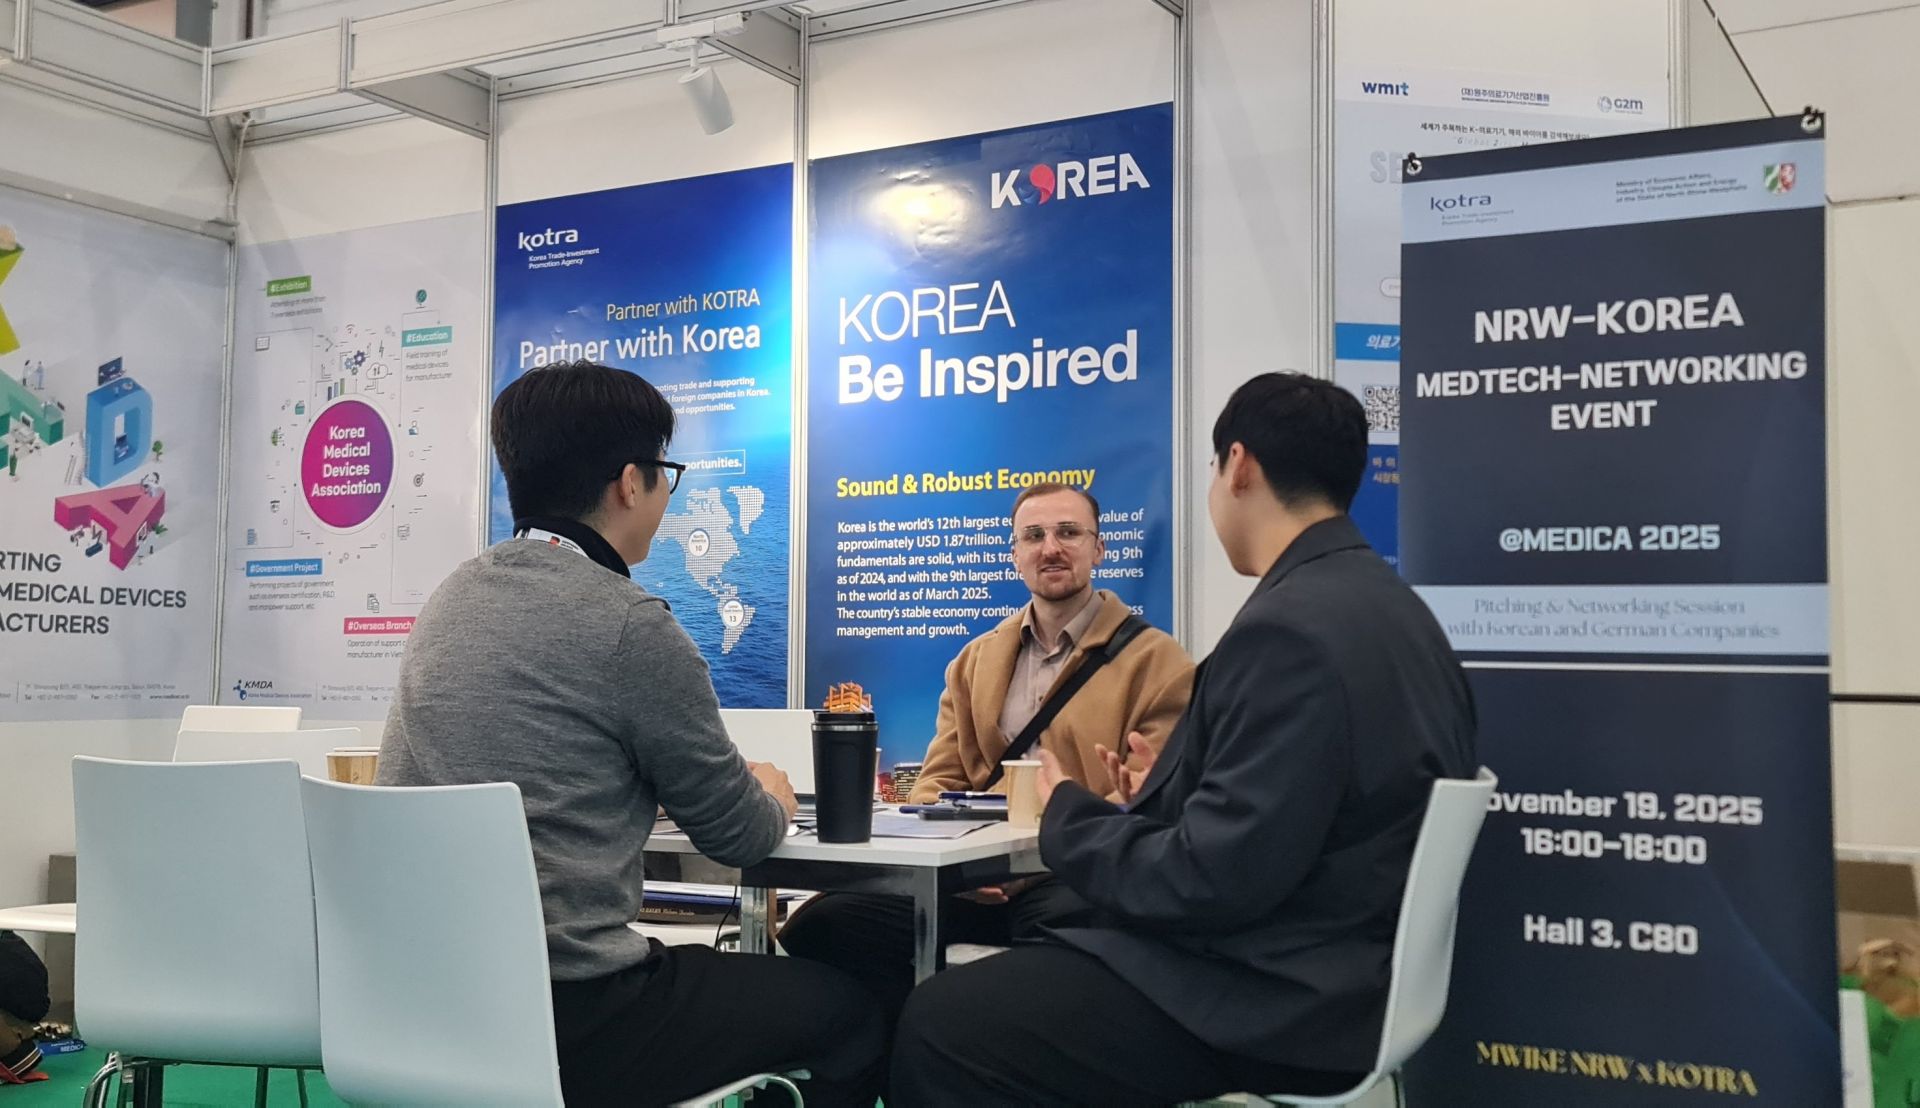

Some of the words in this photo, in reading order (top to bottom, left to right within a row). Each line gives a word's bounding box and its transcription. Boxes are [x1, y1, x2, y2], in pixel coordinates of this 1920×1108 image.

[1614, 98, 1643, 110] G2m
[1430, 194, 1492, 212] kotra
[518, 227, 579, 252] kotra
[548, 247, 600, 260] Trade-Investment
[528, 261, 560, 270] Promotion
[561, 257, 584, 267] Agency
[606, 302, 661, 322] Partner
[664, 293, 698, 317] with
[702, 287, 761, 311] KOTRA
[838, 280, 1017, 345] KOREA
[1474, 292, 1744, 344] NRW-KOREA
[406, 331, 449, 344] #Education
[519, 338, 610, 368] Partner
[616, 325, 673, 360] with
[682, 323, 761, 356] Korea
[838, 354, 904, 404] Be
[920, 329, 1138, 403] Inspired
[1416, 350, 1808, 398] MEDTECH-NETWORKING
[655, 383, 678, 393] oting
[679, 381, 698, 390] trade
[698, 379, 712, 388] and
[713, 376, 755, 389] supporting
[672, 393, 697, 404] foreign
[697, 390, 737, 402] companies
[737, 389, 745, 398] in
[686, 402, 736, 416] opportunities.
[1551, 399, 1658, 431] EVENT
[329, 426, 365, 440] Korea
[324, 442, 371, 459] Medical
[323, 464, 370, 478] Devices
[685, 457, 743, 471] portunities.
[311, 481, 382, 497] Association
[836, 474, 898, 498] Sound
[902, 474, 918, 494] &
[922, 471, 993, 493] Robust
[997, 468, 1096, 490] Economy
[838, 521, 866, 533] Korea
[868, 520, 877, 532] is
[878, 519, 896, 532] the
[897, 517, 934, 531] world's
[937, 517, 960, 530] 12th
[963, 515, 1000, 531] largest
[1098, 509, 1128, 523] value
[1130, 508, 1144, 522] of
[837, 535, 914, 553] approximately
[916, 535, 941, 548] USD
[1099, 528, 1144, 541] onomic
[1499, 525, 1633, 552] @MEDICA
[1640, 524, 1720, 551] 2025
[837, 554, 907, 568] fundamentals
[908, 555, 925, 566] are
[927, 552, 955, 567] solid,
[957, 551, 981, 564] with
[983, 550, 996, 563] its
[998, 551, 1013, 563] tra
[1122, 546, 1143, 560] 9th
[294, 562, 319, 573] Project
[837, 574, 848, 585] as
[849, 572, 859, 584] of
[860, 571, 886, 585] 2024,
[887, 571, 907, 583] and
[908, 570, 930, 583] with
[931, 570, 948, 582] the
[950, 569, 967, 582] 9th
[968, 568, 1003, 584] largest
[1005, 567, 1025, 580] fore
[1098, 567, 1144, 579] reserves
[0, 582, 95, 604] MEDICAL
[100, 585, 187, 608] DEVICES
[837, 590, 846, 602] in
[849, 589, 866, 602] the
[867, 588, 897, 601] world
[899, 590, 910, 601] as
[912, 588, 924, 600] of
[925, 587, 959, 600] March
[961, 586, 992, 600] 2025.
[837, 607, 855, 619] The
[856, 606, 900, 621] country's
[901, 605, 932, 618] stable
[932, 606, 980, 621] economy
[981, 605, 1021, 617] contin
[1474, 597, 1543, 619] Pitching
[1568, 598, 1670, 619] Networking
[1674, 599, 1745, 615] Session
[348, 621, 385, 631] #Overseas
[386, 620, 411, 631] Branch
[729, 615, 737, 623] 13
[837, 626, 904, 639] management
[905, 624, 926, 636] and
[928, 623, 970, 638] growth.
[1447, 619, 1484, 636] with
[1486, 619, 1550, 637] Korean
[1551, 620, 1587, 637] and
[1590, 621, 1667, 638] German
[1672, 622, 1780, 642] Companies
[244, 680, 273, 689] KMDA
[1487, 789, 1618, 818] ovember
[1673, 793, 1764, 825] 2025
[1520, 827, 1708, 865] 16:00-18:00
[1523, 914, 1584, 946] Hall
[1475, 1039, 1567, 1073] MWIKE
[1570, 1050, 1635, 1081] NRW
[1656, 1059, 1759, 1097] KOTRA
